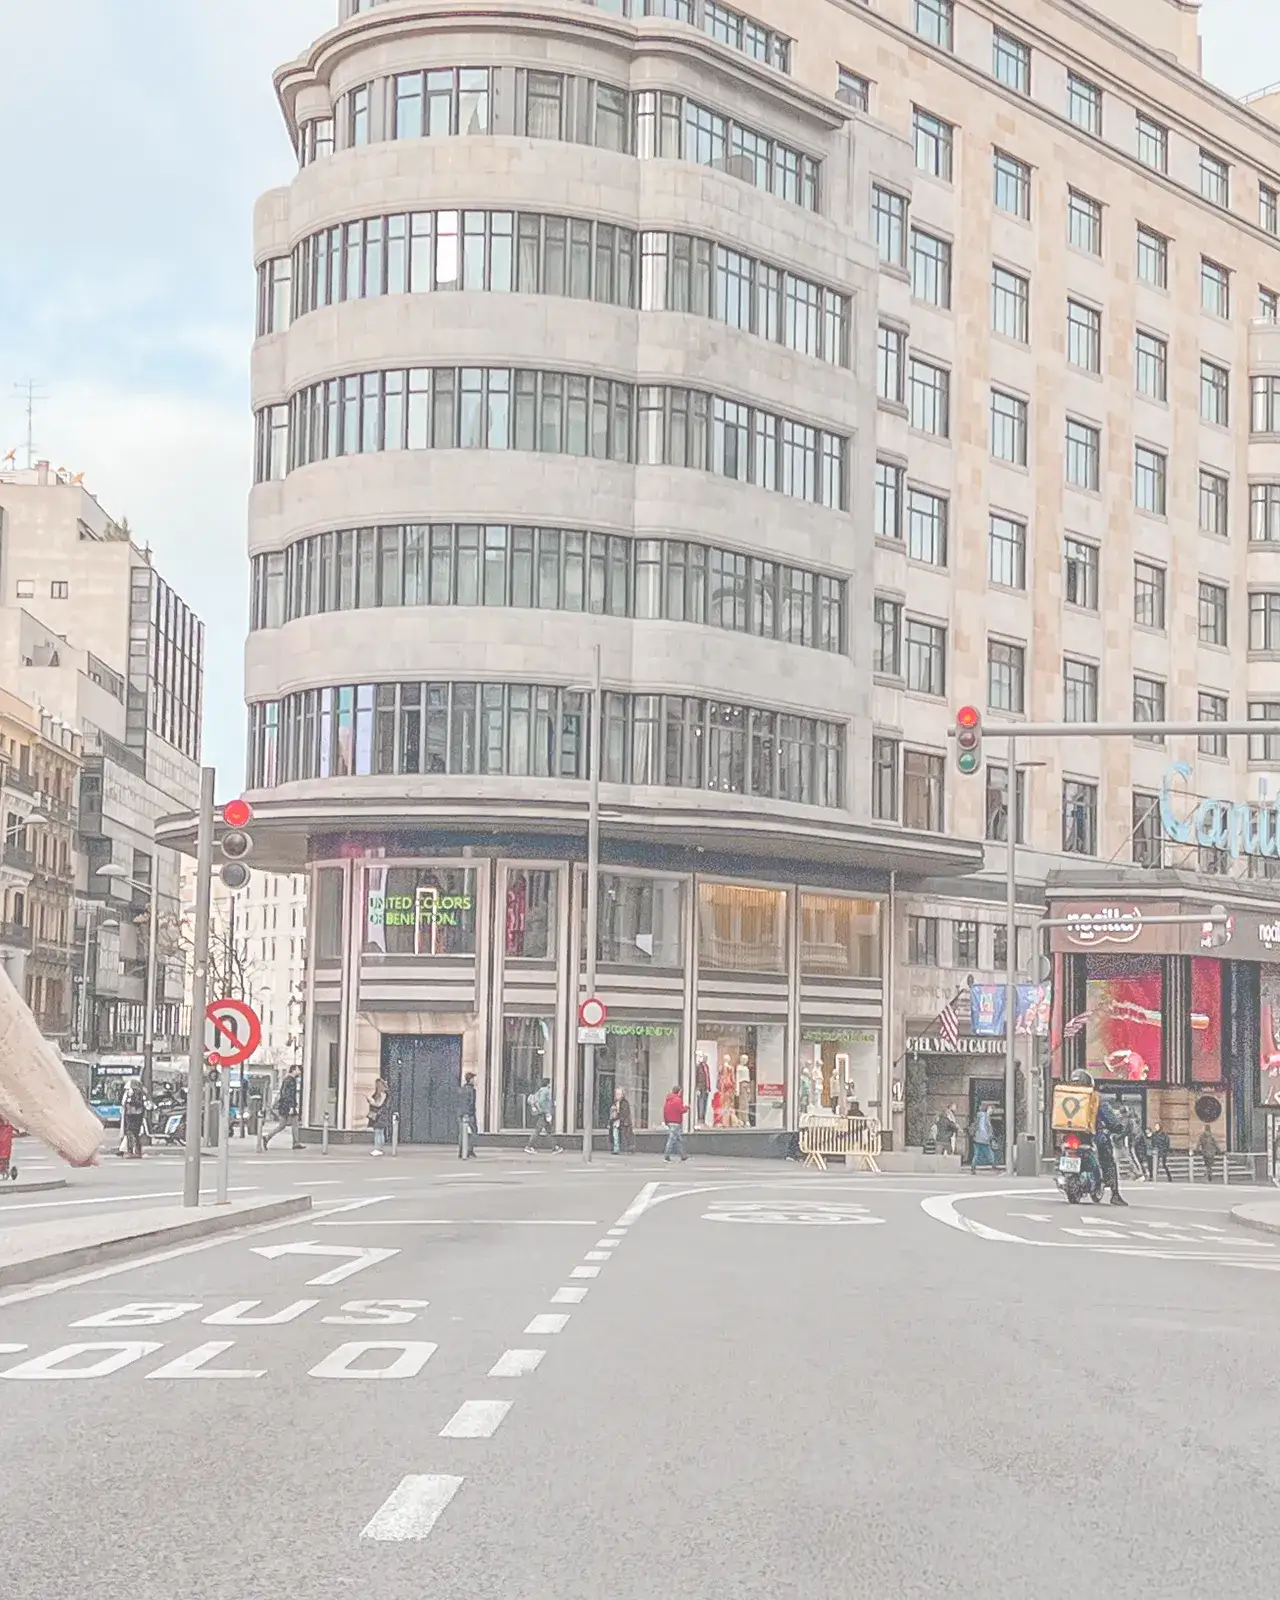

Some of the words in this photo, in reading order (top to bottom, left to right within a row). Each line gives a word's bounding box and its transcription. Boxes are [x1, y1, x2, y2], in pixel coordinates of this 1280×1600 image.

[369, 897, 412, 909] UNITED
[418, 896, 472, 909] COLORS
[1067, 908, 1135, 932] nocilla
[69, 1300, 431, 1327] BUS
